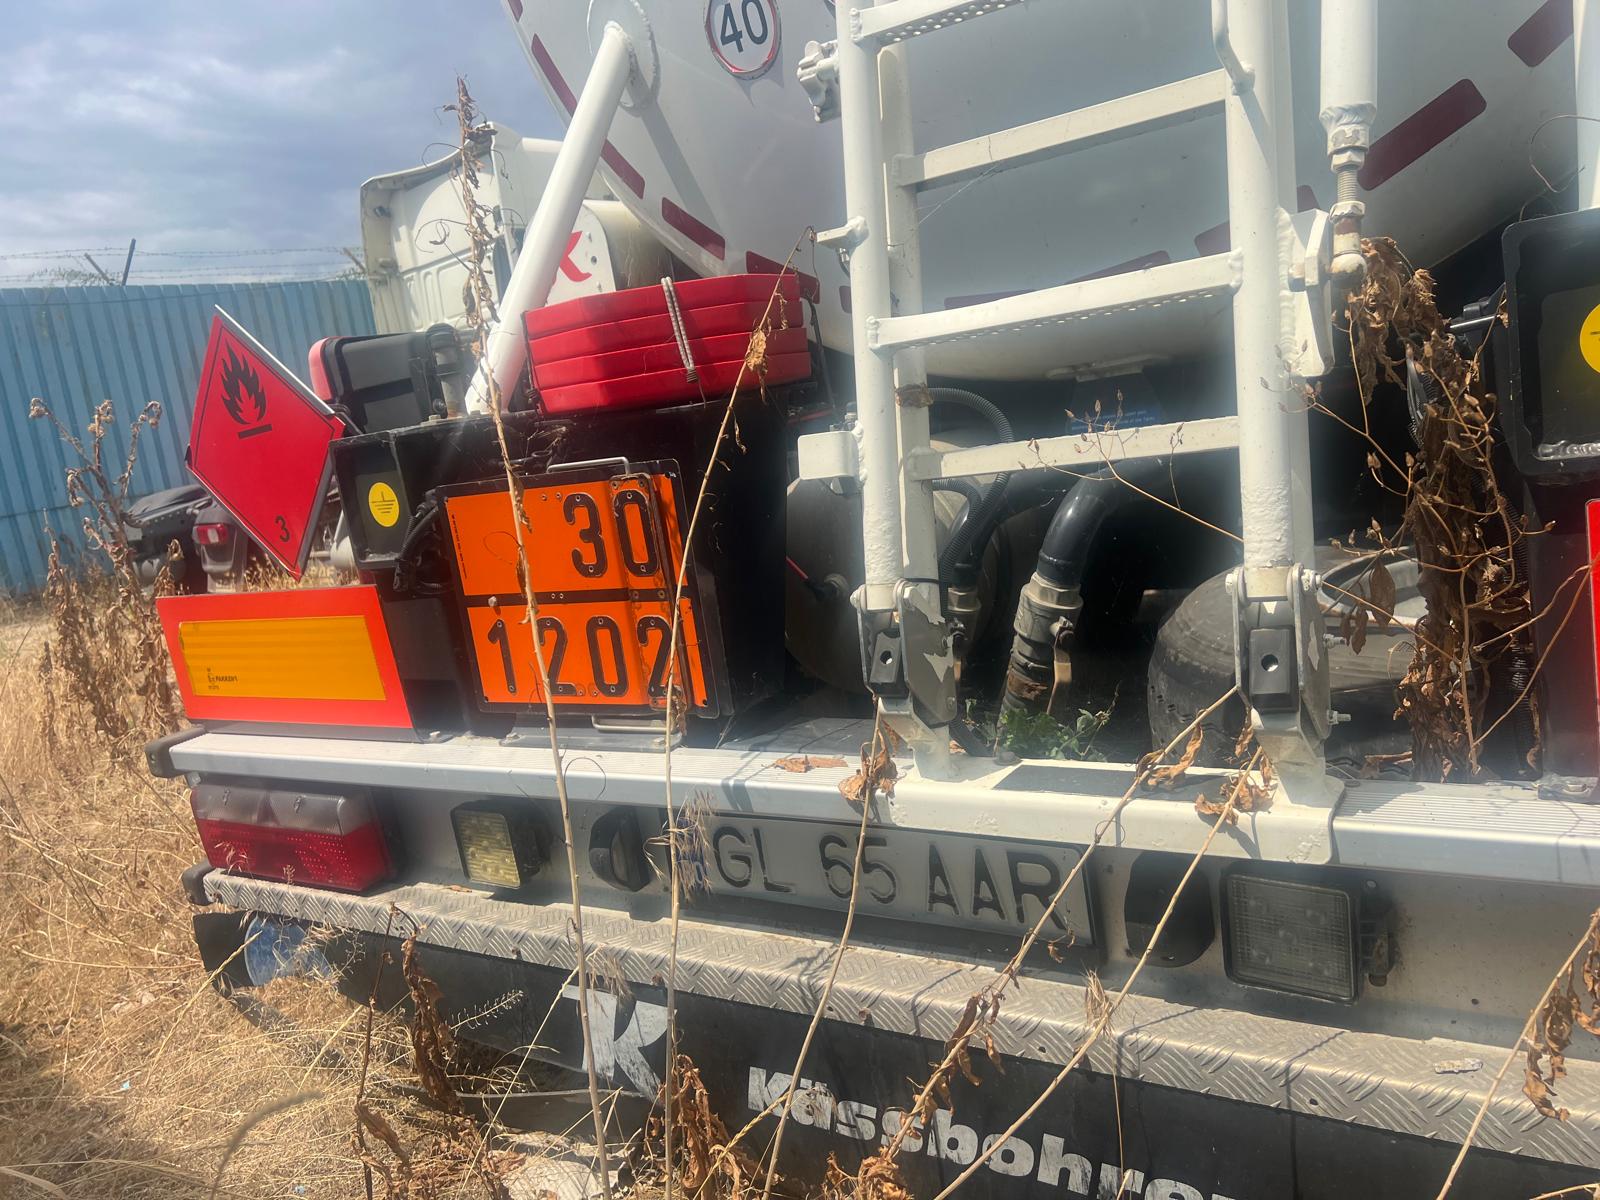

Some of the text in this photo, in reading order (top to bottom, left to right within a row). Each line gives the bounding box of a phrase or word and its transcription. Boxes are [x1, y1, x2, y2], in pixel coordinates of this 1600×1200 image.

[720, 0, 768, 53] 40
[274, 515, 290, 543] 3
[563, 489, 659, 578] 30
[487, 615, 681, 697] 1202
[712, 826, 1068, 931] GL 65 AAR
[747, 1066, 1237, 1200] Kässbohr
